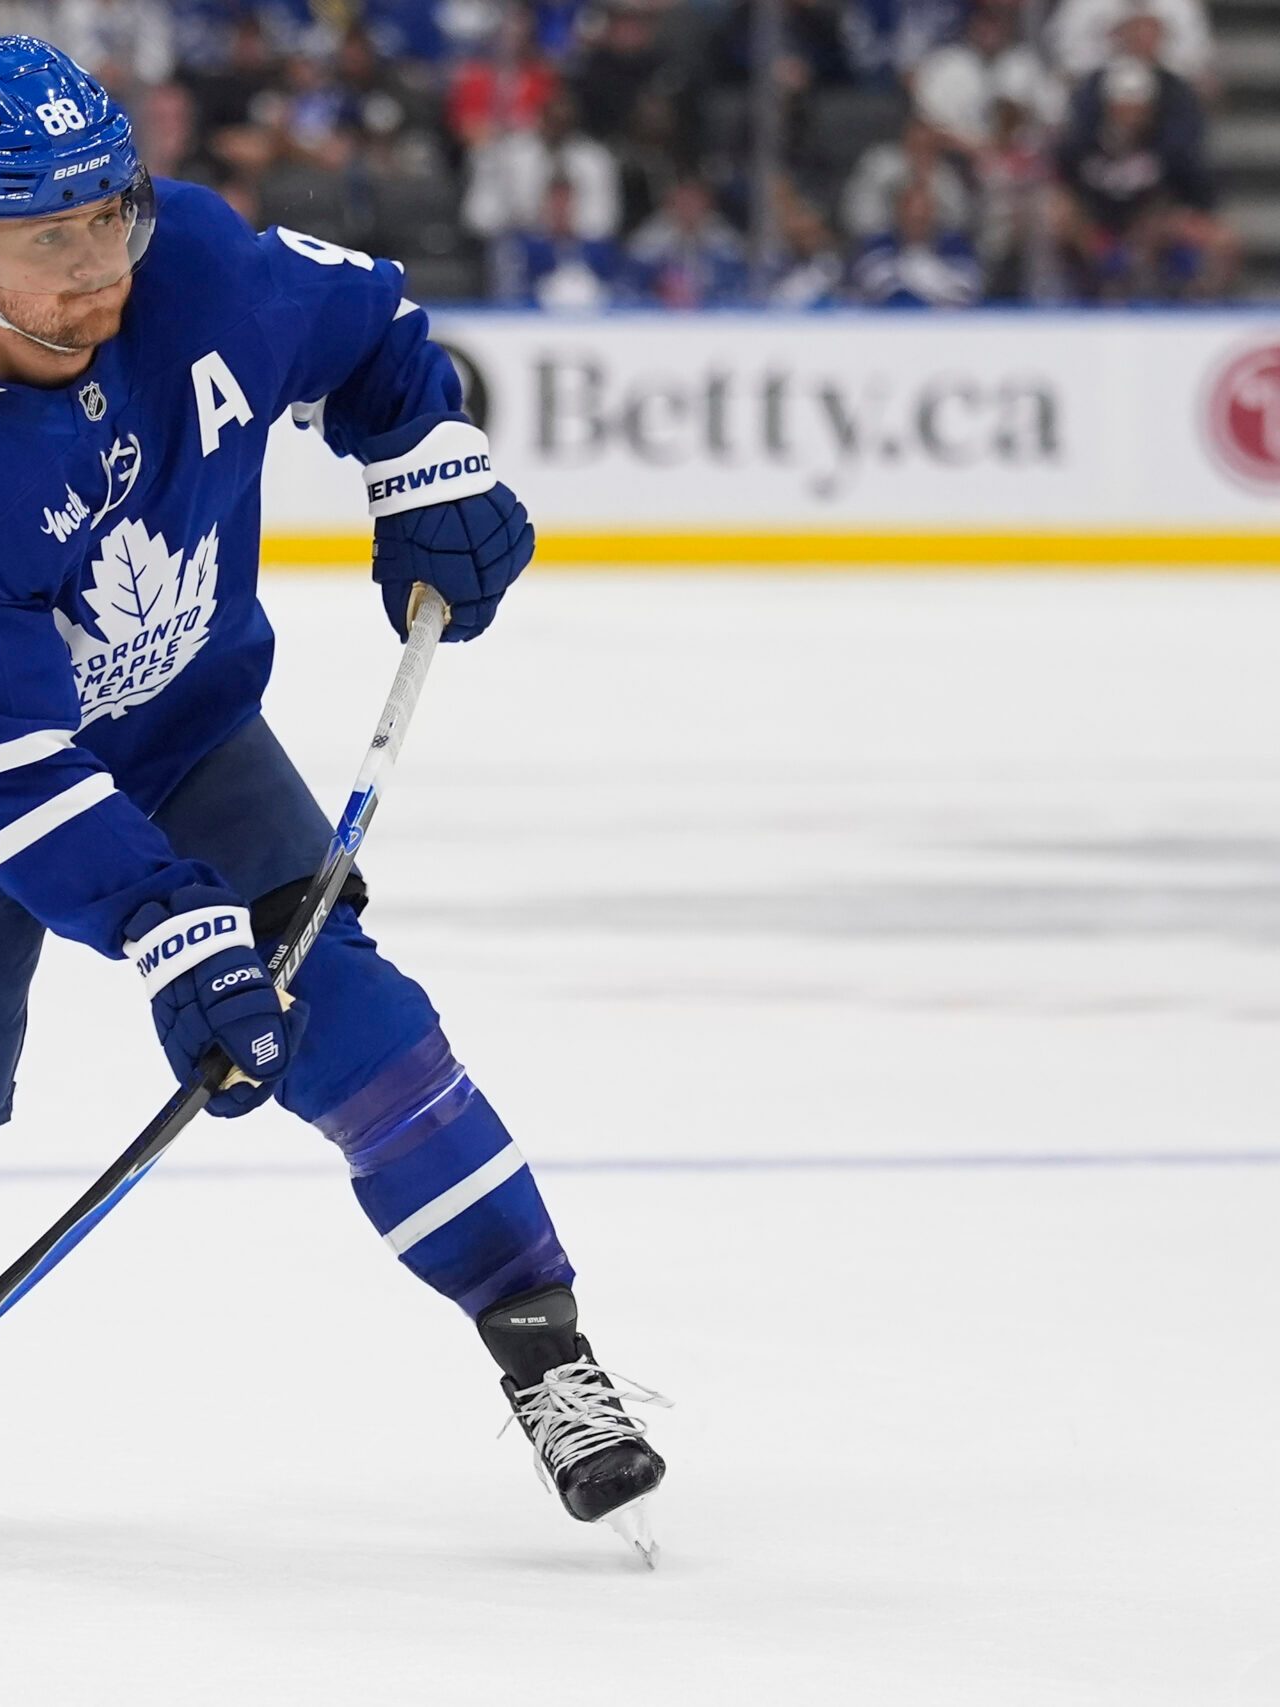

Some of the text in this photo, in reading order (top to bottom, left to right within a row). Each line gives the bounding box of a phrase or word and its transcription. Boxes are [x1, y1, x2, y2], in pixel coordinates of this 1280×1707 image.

[36, 98, 86, 136] 88
[53, 154, 111, 181] BAUER
[191, 350, 254, 458] A
[530, 356, 1062, 500] Betty.ca
[368, 455, 491, 503] ERWOOD
[73, 605, 201, 679] TORONTO
[83, 636, 182, 688] MAPLE
[80, 656, 176, 706] LEAFS
[136, 915, 237, 978] WOOD
[274, 897, 327, 990] AUER
